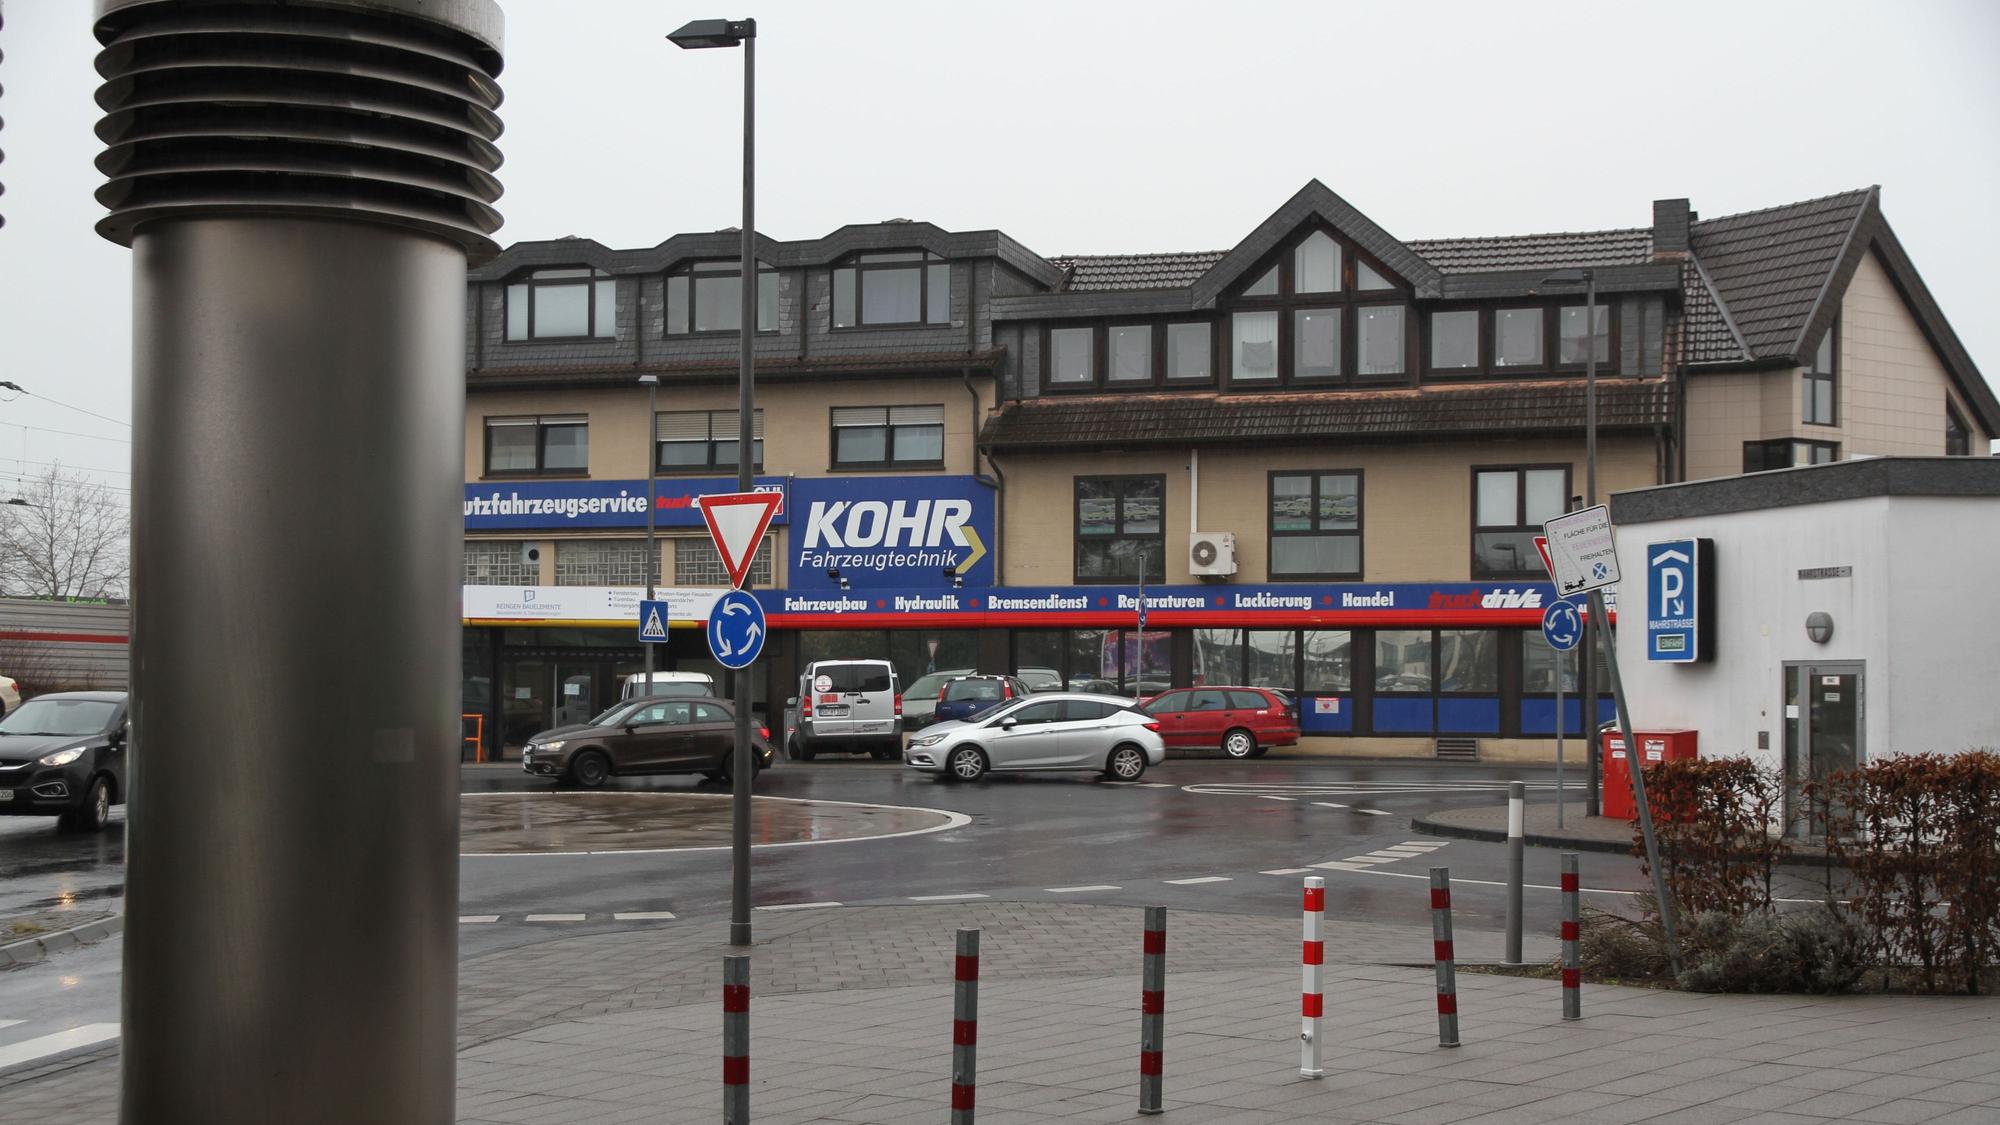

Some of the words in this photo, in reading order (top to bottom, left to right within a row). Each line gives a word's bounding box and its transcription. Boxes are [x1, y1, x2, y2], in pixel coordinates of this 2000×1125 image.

[799, 549, 958, 571] Fahrzeugtechnik
[1580, 548, 1614, 560] FREIHALTEN
[784, 596, 868, 613] Fahrzeugbau
[894, 595, 960, 612] Hydraulik
[987, 594, 1089, 610] Bremsendienst
[1117, 593, 1205, 611] Reparaturen
[1235, 592, 1312, 610] Lackierung
[1342, 590, 1394, 607] Handel
[1649, 618, 1695, 630] MAHRSTRASSE
